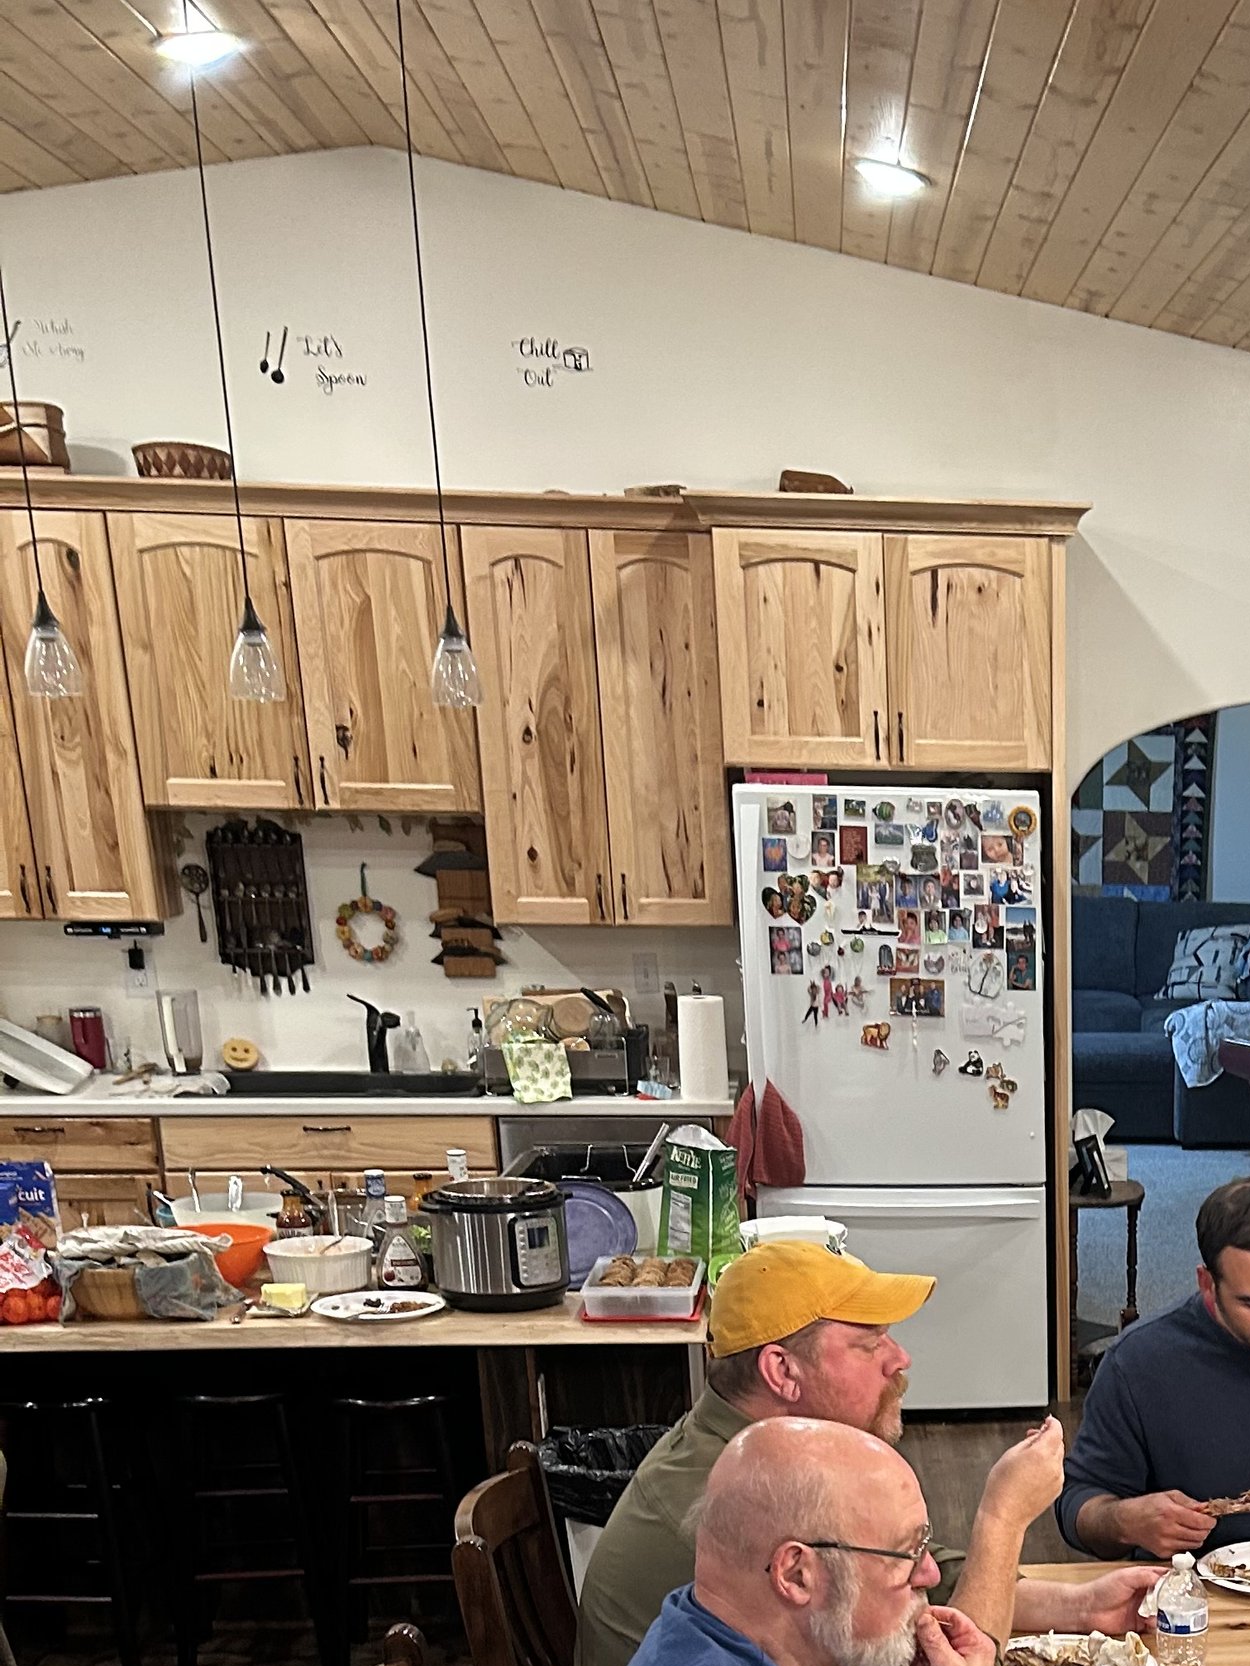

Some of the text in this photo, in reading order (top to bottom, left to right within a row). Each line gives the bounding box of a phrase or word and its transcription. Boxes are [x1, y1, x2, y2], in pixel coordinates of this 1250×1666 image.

[512, 337, 560, 359] Chill
[315, 364, 367, 395] Spoon
[517, 366, 554, 387] Out
[18, 1187, 46, 1201] cuit
